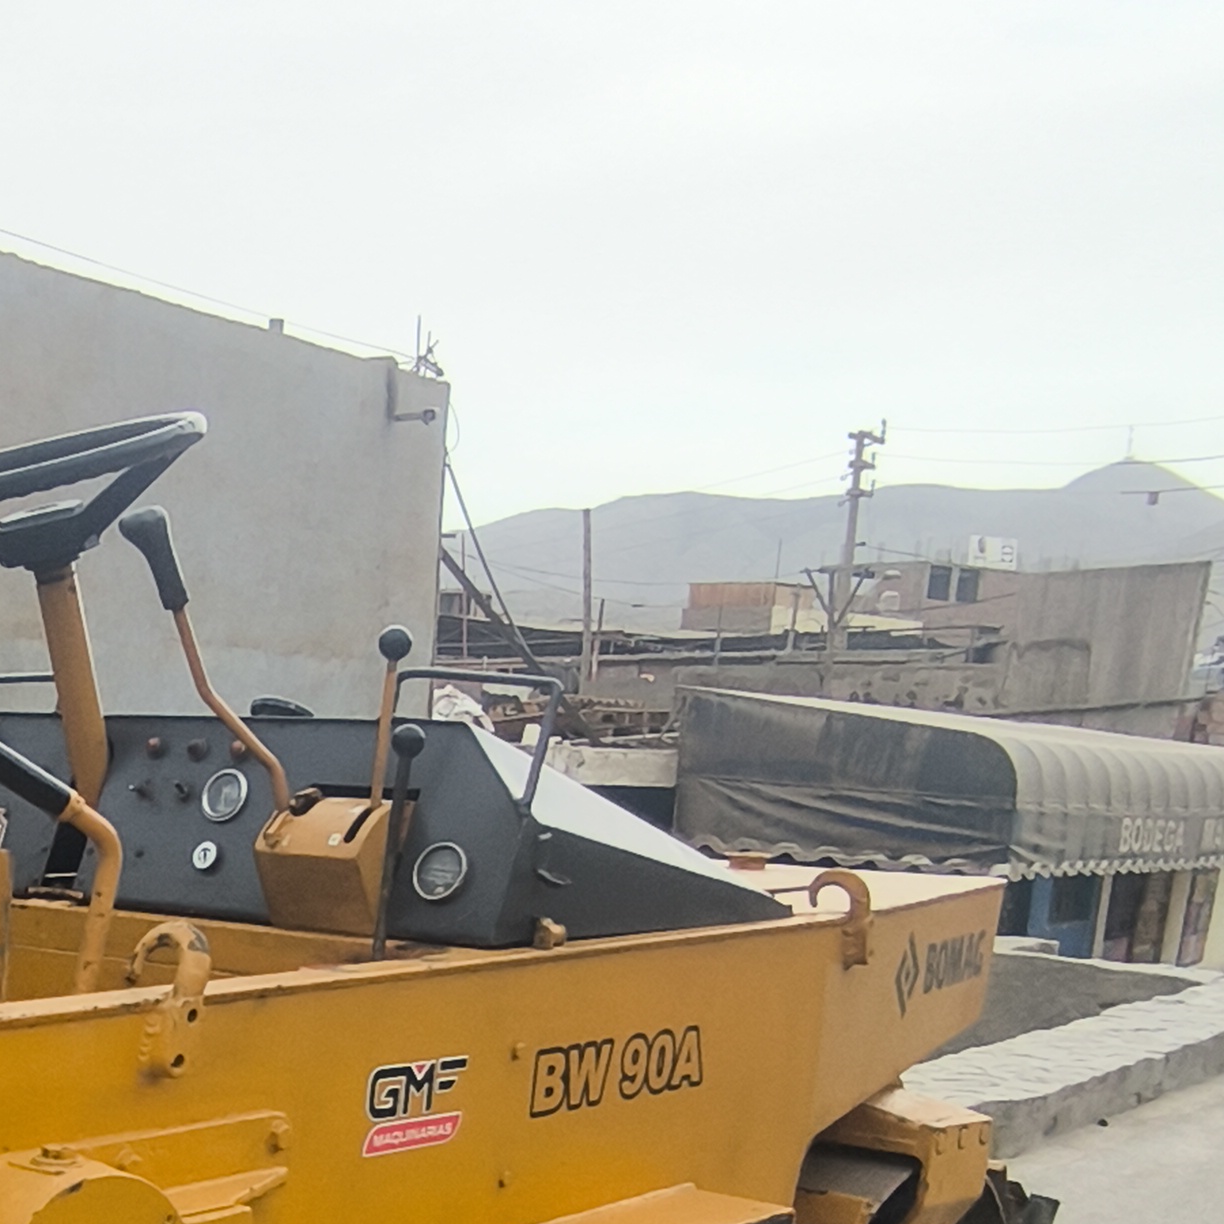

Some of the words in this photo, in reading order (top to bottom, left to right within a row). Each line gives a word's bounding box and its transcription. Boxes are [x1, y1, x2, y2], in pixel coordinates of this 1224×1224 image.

[1118, 817, 1185, 854] BODEGA
[923, 929, 986, 994] BOMAG
[367, 1055, 469, 1122] GMF
[529, 1038, 614, 1118] BW
[619, 1024, 702, 1100] 90A
[372, 1121, 454, 1148] MAQUINARIAS
